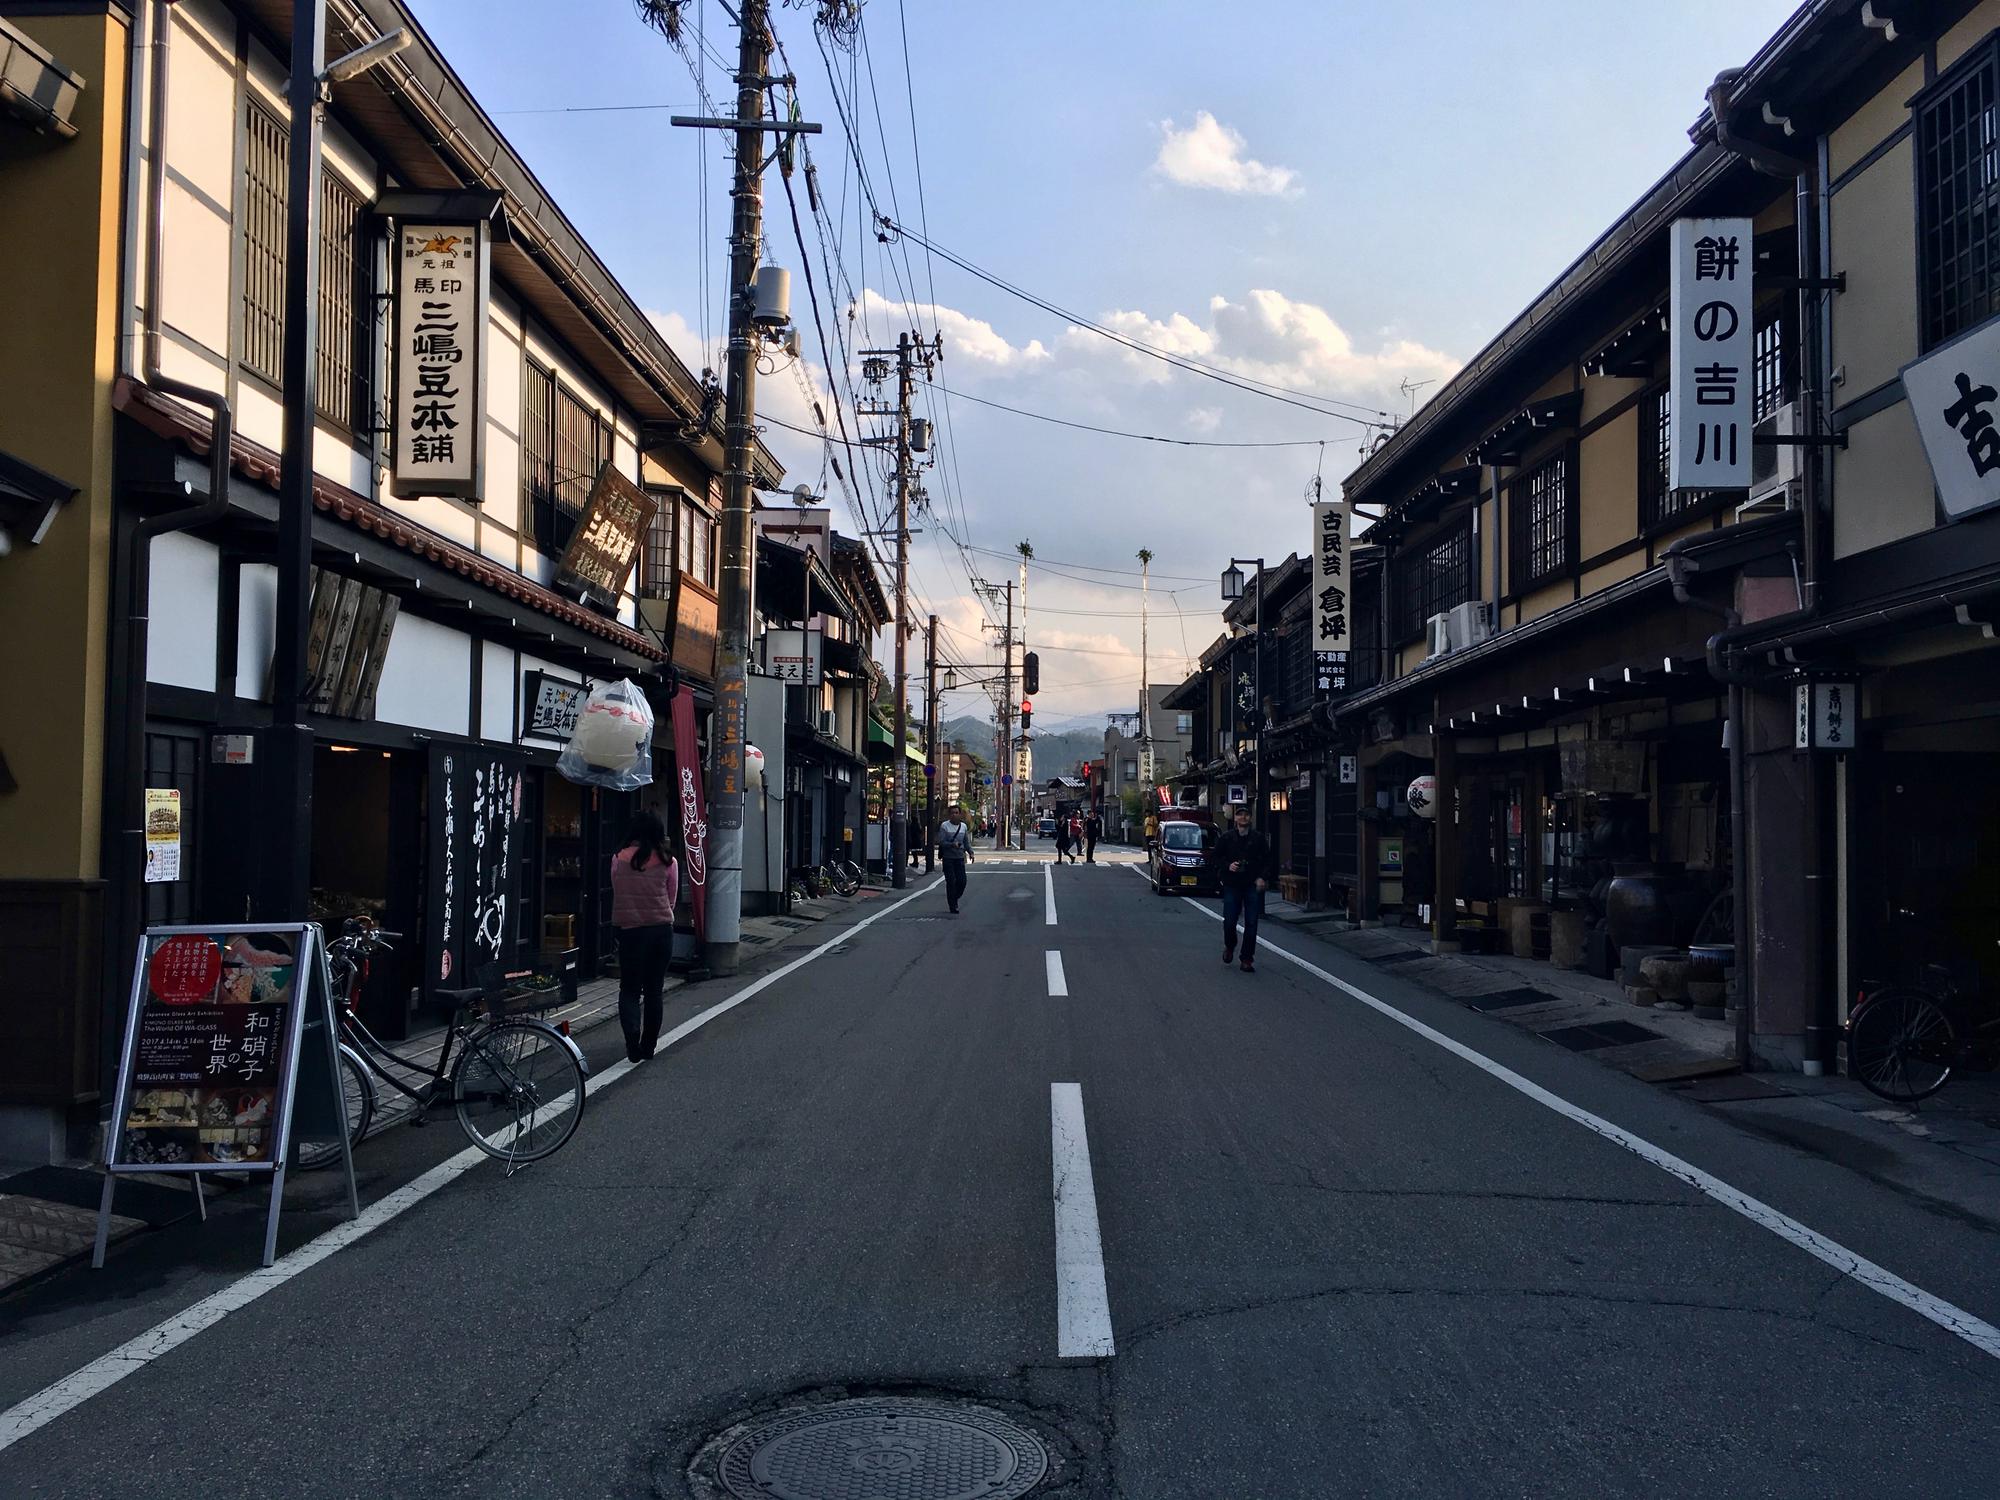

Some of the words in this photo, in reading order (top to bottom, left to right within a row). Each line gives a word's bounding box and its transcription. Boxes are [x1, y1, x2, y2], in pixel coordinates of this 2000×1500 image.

[414, 278, 462, 294] 馬印
[1694, 236, 1739, 465] 餅の吉川
[411, 301, 463, 465] 三嶋豆本舗
[1322, 510, 1343, 576] 古民芸
[1319, 586, 1346, 640] 倉坪
[1317, 652, 1347, 662] 不動産
[1319, 666, 1345, 674] 株式会社
[1318, 676, 1346, 690] 倉坪
[206, 1033, 232, 1074] 世界
[228, 1052, 241, 1064] の
[238, 1012, 270, 1080] 和硝子
